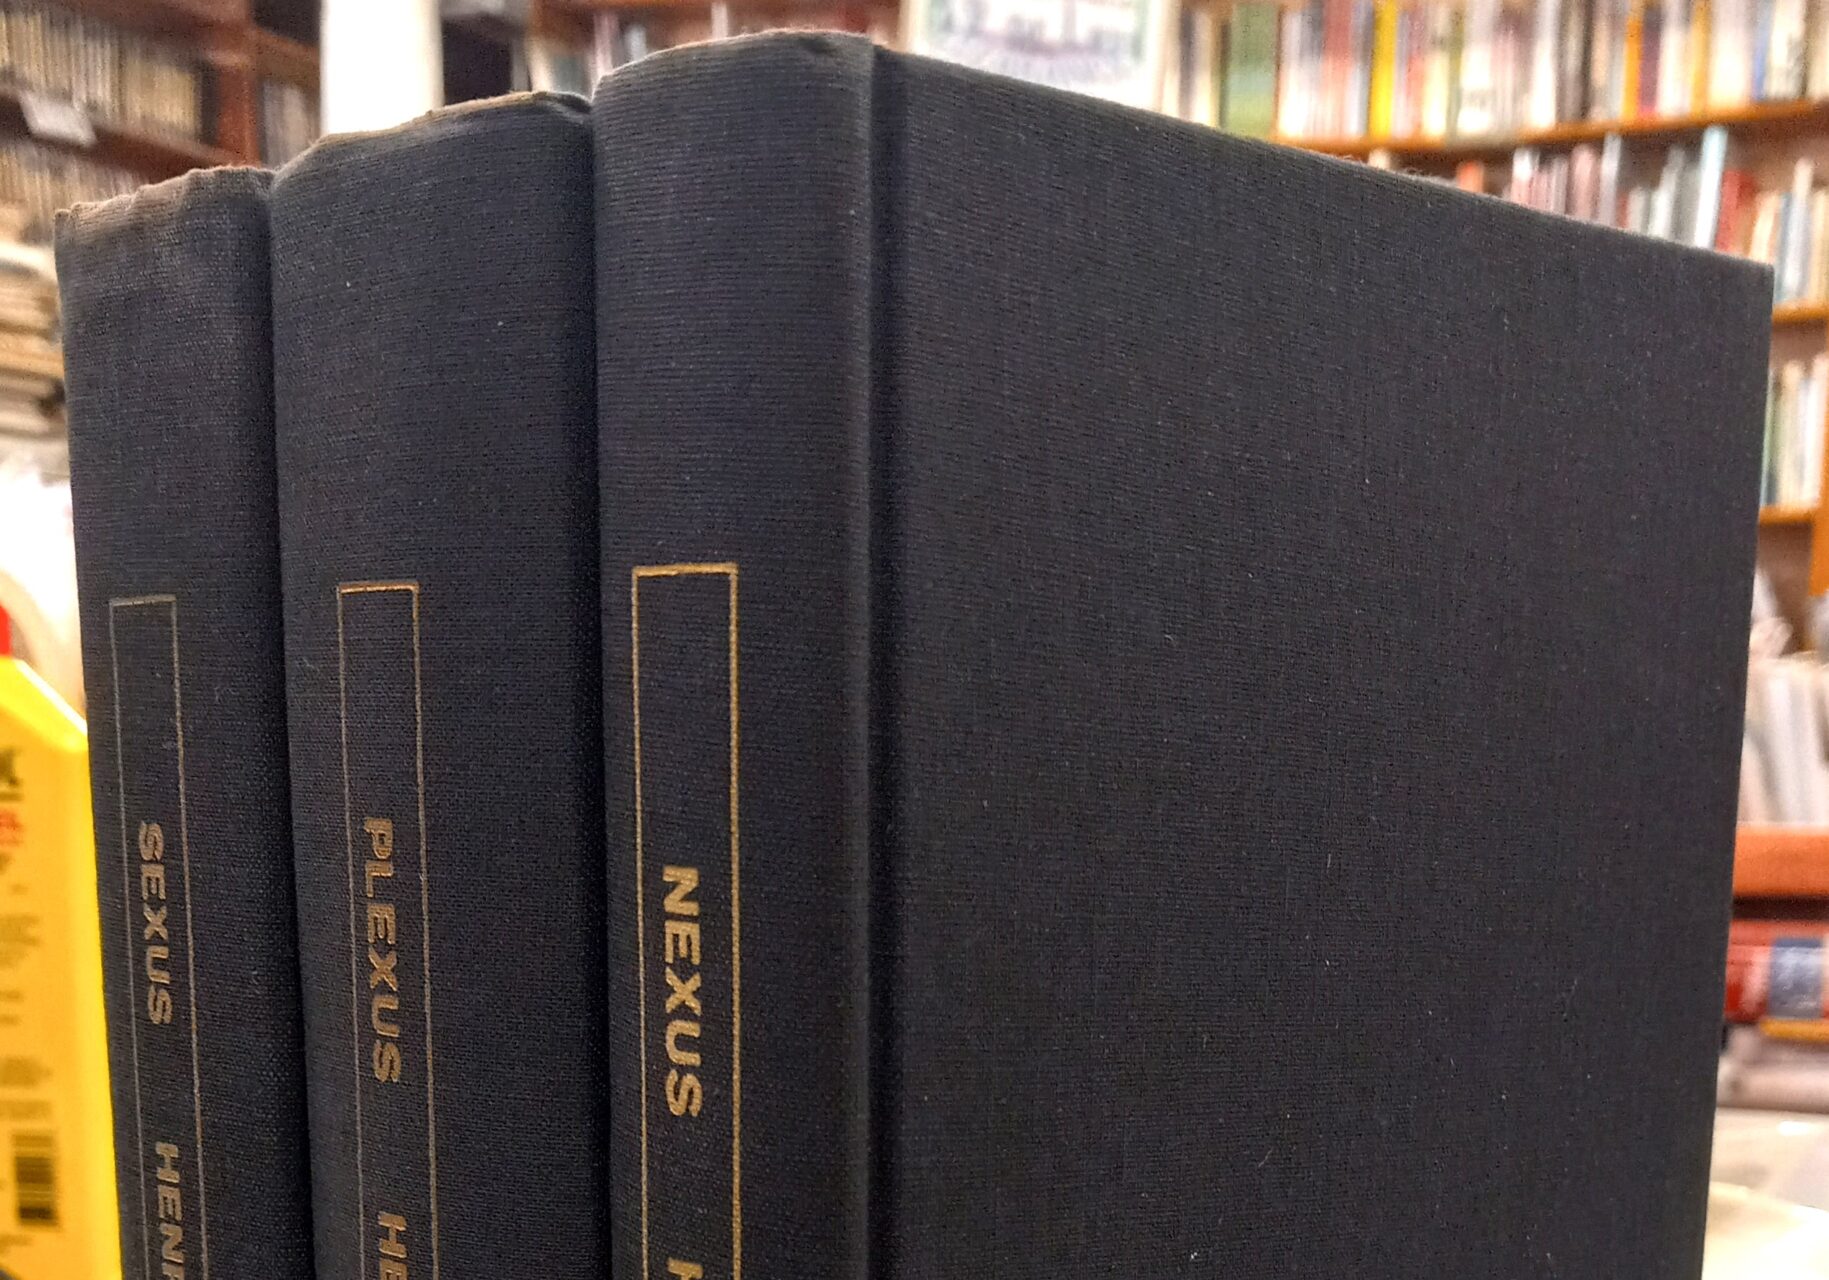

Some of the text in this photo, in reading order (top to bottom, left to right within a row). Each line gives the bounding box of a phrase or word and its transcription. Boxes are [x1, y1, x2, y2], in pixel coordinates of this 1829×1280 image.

[139, 820, 173, 1025] SEXUS
[364, 817, 401, 1083] PLEXUS
[662, 866, 703, 1117] NEXUS
